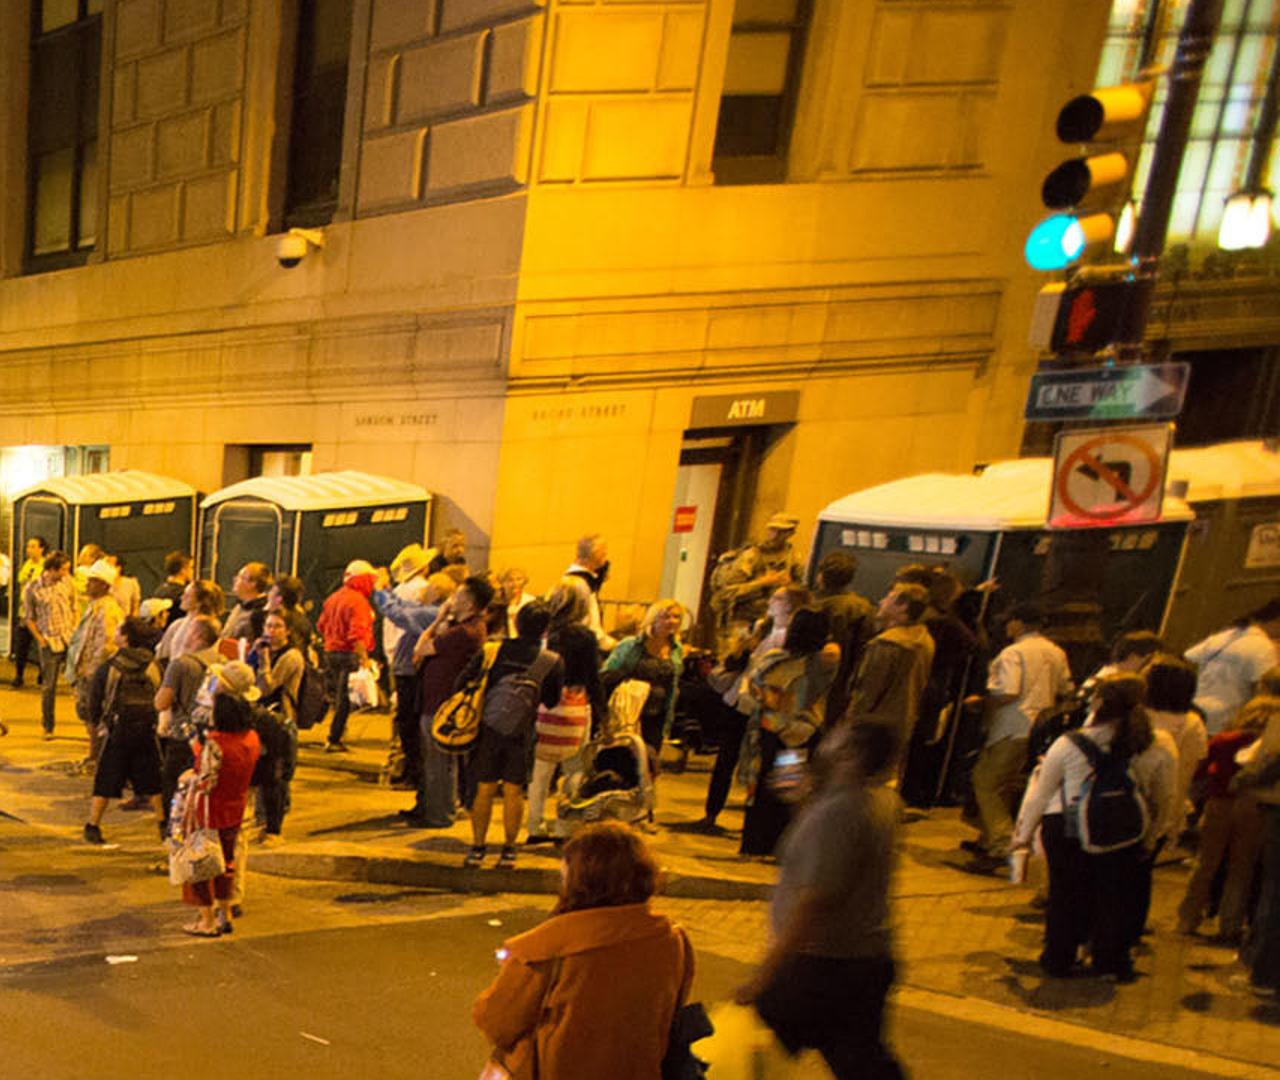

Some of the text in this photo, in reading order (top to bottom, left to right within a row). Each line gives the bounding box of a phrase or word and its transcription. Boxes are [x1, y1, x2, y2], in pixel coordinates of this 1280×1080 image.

[1041, 377, 1134, 406] ONE WAY
[580, 404, 627, 418] STREET
[727, 398, 766, 419] ATM
[400, 413, 438, 426] STREET
